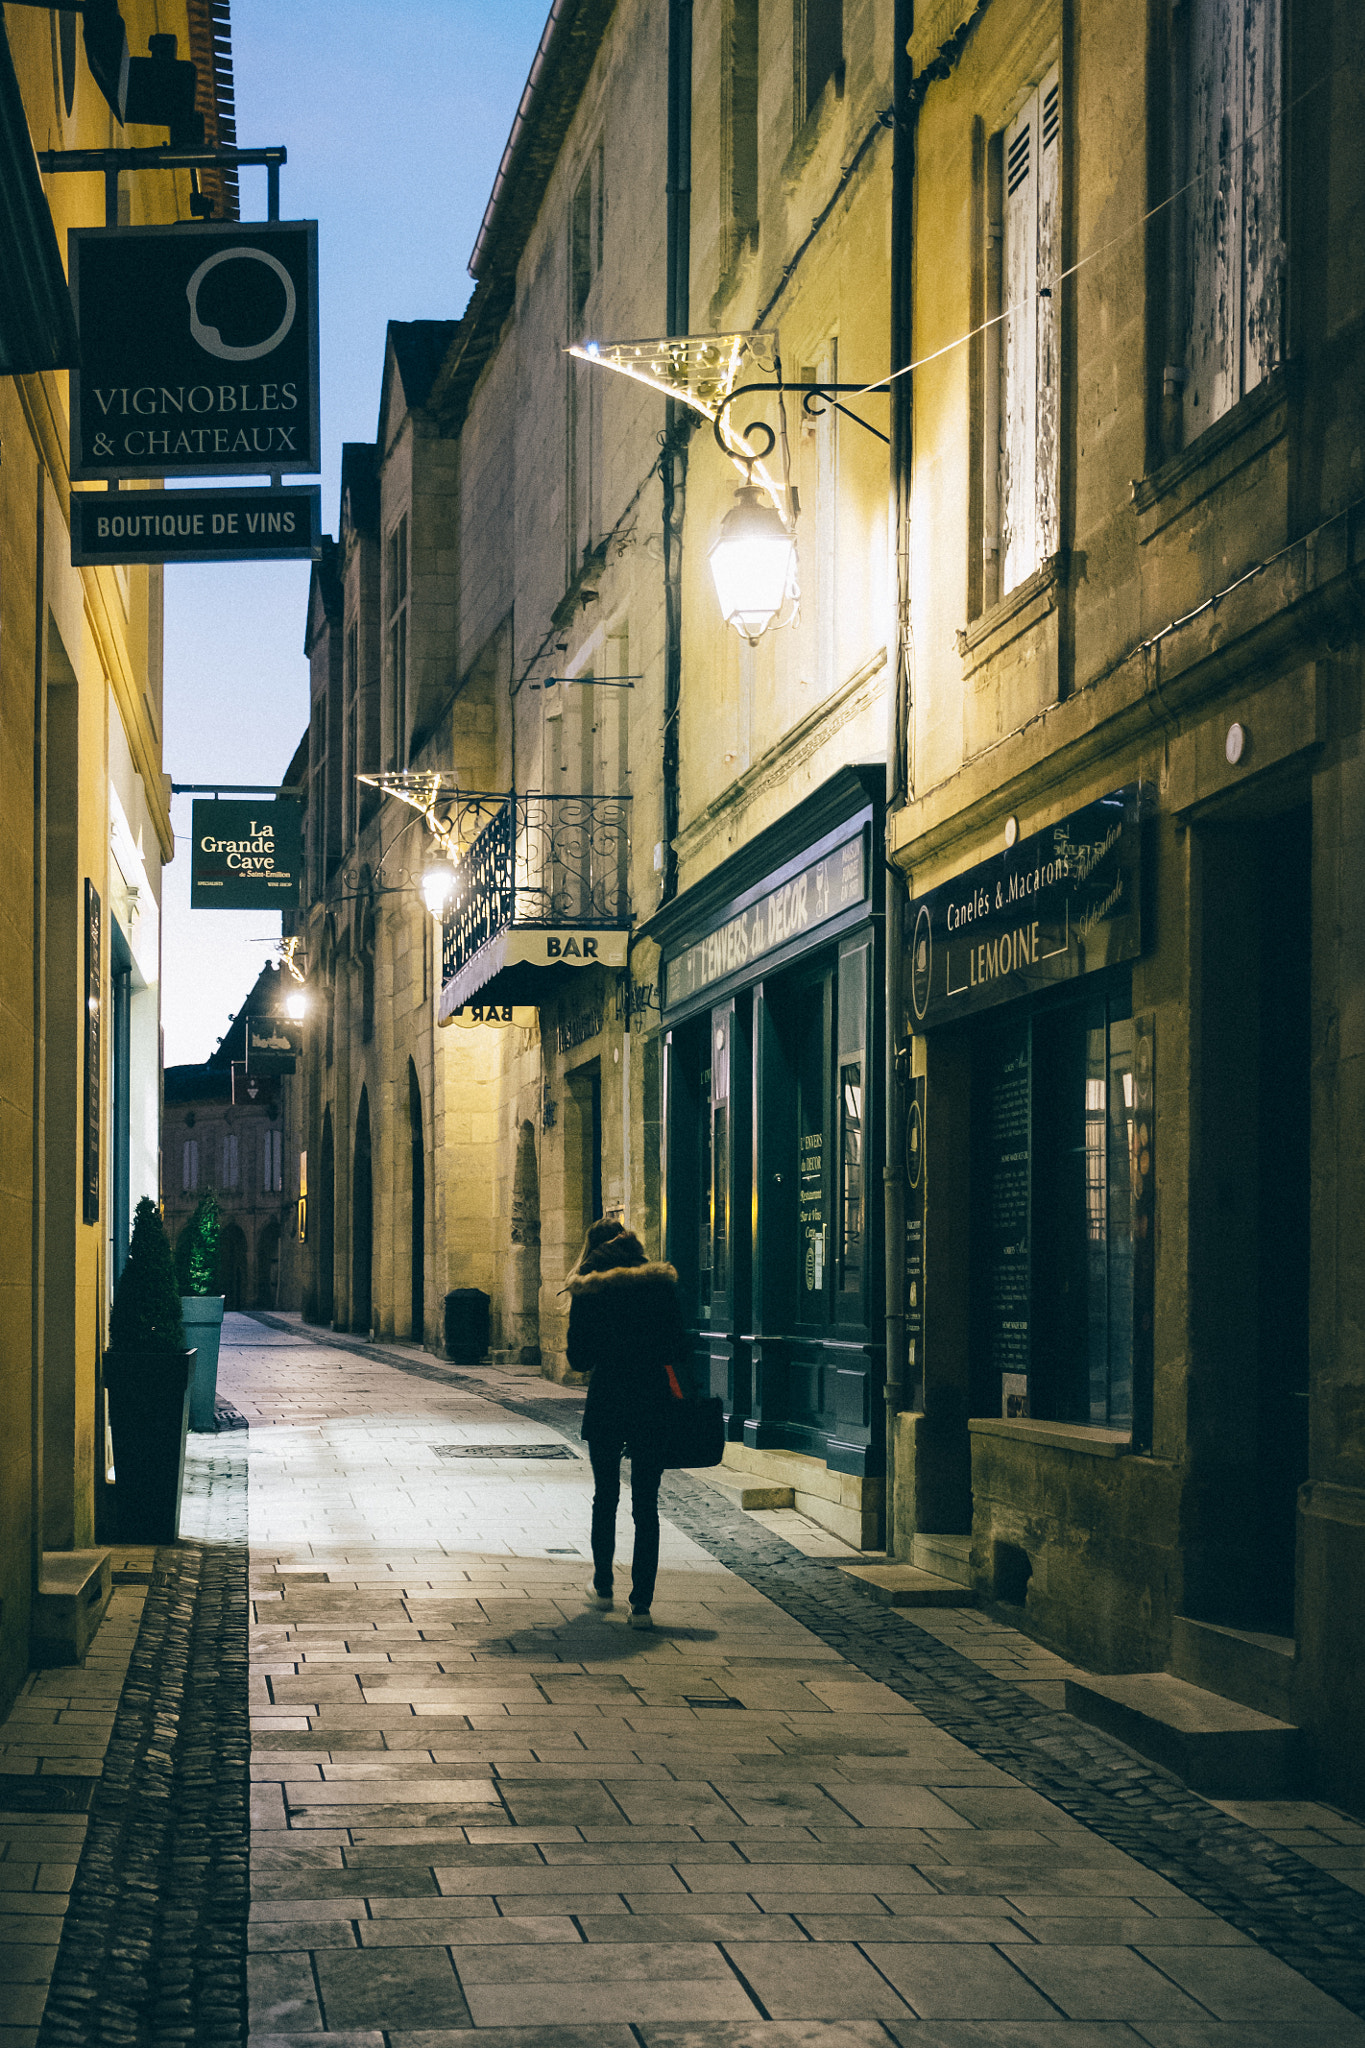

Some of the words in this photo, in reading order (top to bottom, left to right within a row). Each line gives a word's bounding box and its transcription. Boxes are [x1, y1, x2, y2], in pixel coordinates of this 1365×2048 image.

[92, 383, 298, 415] VIGNOBLES
[92, 432, 115, 456] &
[124, 427, 297, 455] CHATEAUX
[97, 514, 204, 537] BOUTIQUE
[212, 513, 239, 534] DE
[246, 512, 296, 533] VINS
[250, 821, 274, 837] La
[201, 837, 275, 853] Grande
[226, 853, 275, 869] Cave
[947, 887, 990, 931] Canelés
[995, 881, 1003, 910] &
[1006, 855, 1070, 903] Macarons
[701, 912, 749, 981] L'ENVERS
[767, 873, 808, 945] DÉCOR
[546, 936, 599, 958] BAR
[970, 921, 1039, 986] LEMOINE
